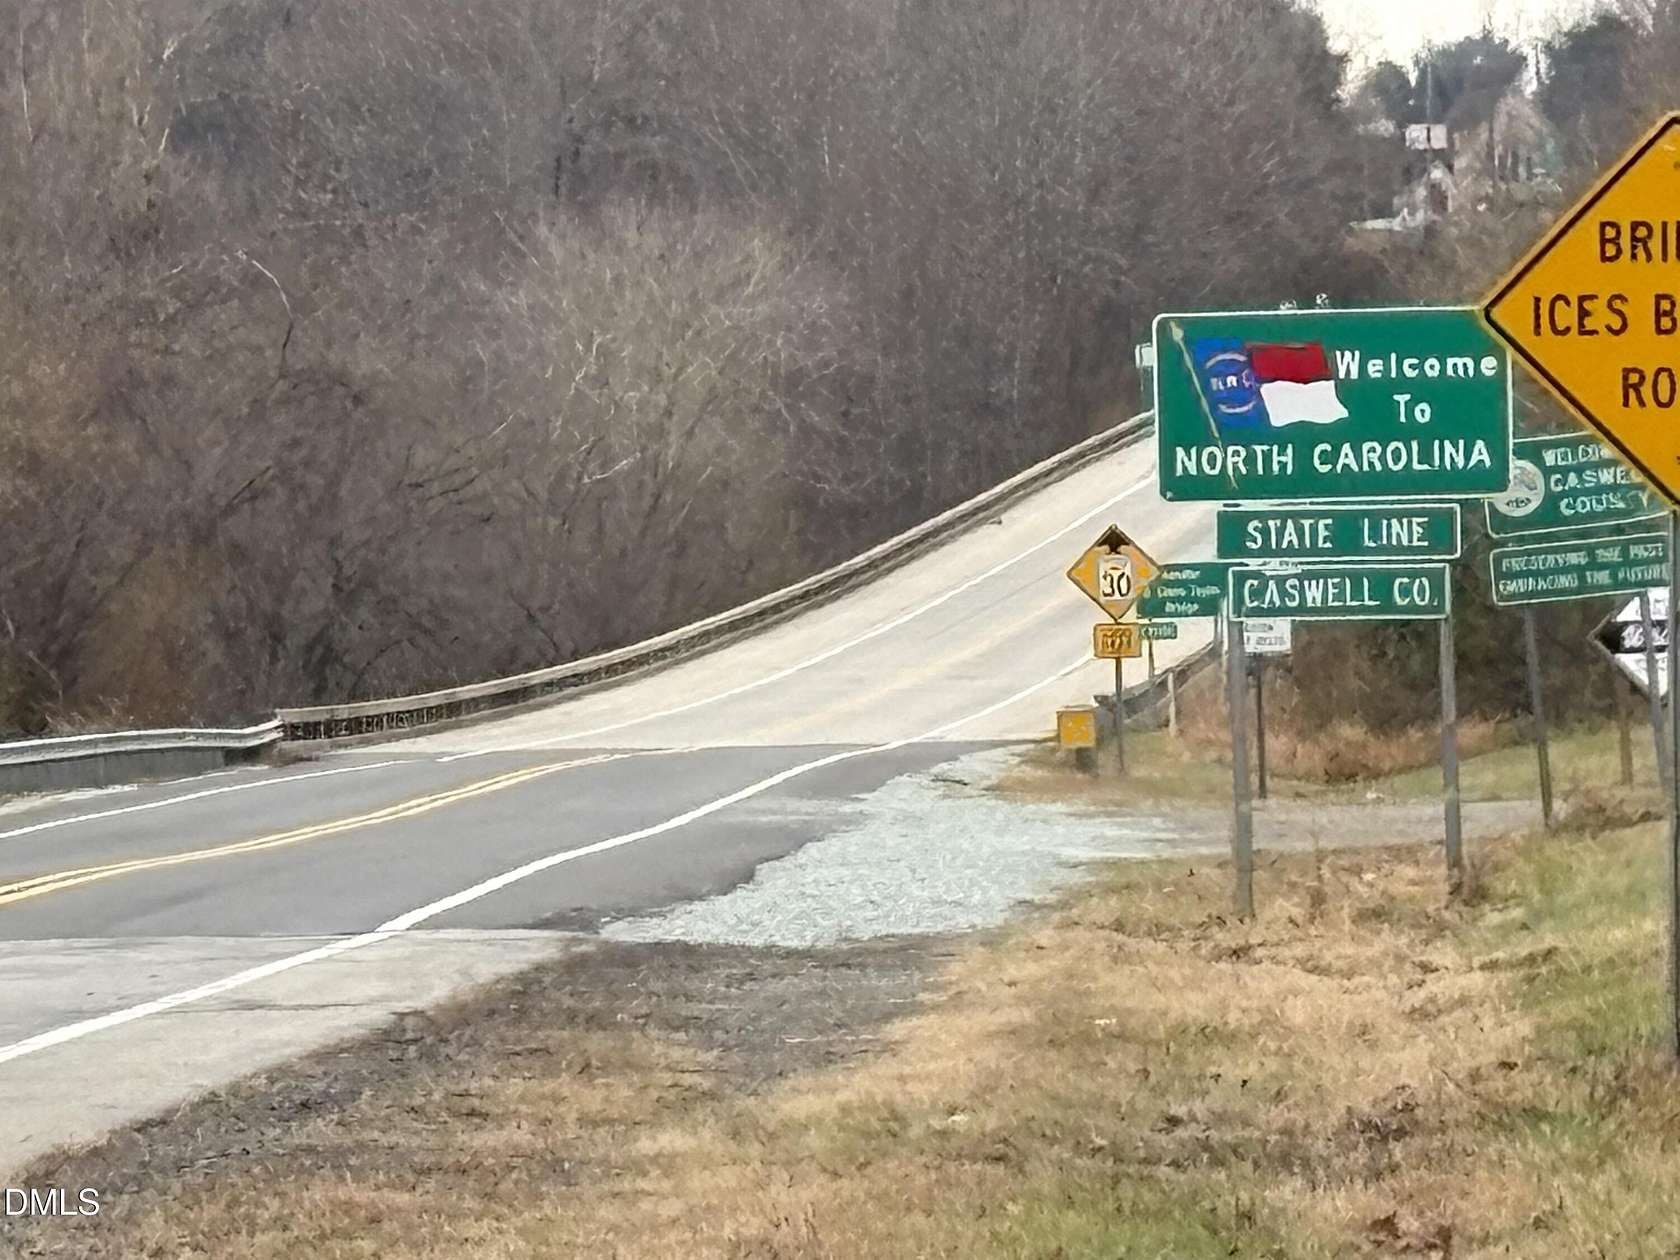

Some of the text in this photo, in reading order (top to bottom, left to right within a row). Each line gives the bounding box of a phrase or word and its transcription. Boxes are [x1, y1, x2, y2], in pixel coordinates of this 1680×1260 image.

[1599, 220, 1680, 263] BRI
[1533, 293, 1629, 336] ICES
[1335, 350, 1498, 380] Welcome
[1393, 394, 1432, 423] To
[1175, 440, 1492, 477] NORTH CAROLINA
[1245, 517, 1430, 550] STATE LINE
[1101, 571, 1132, 598] 30
[1243, 576, 1381, 609] CASWELL
[1393, 577, 1439, 607] CO.
